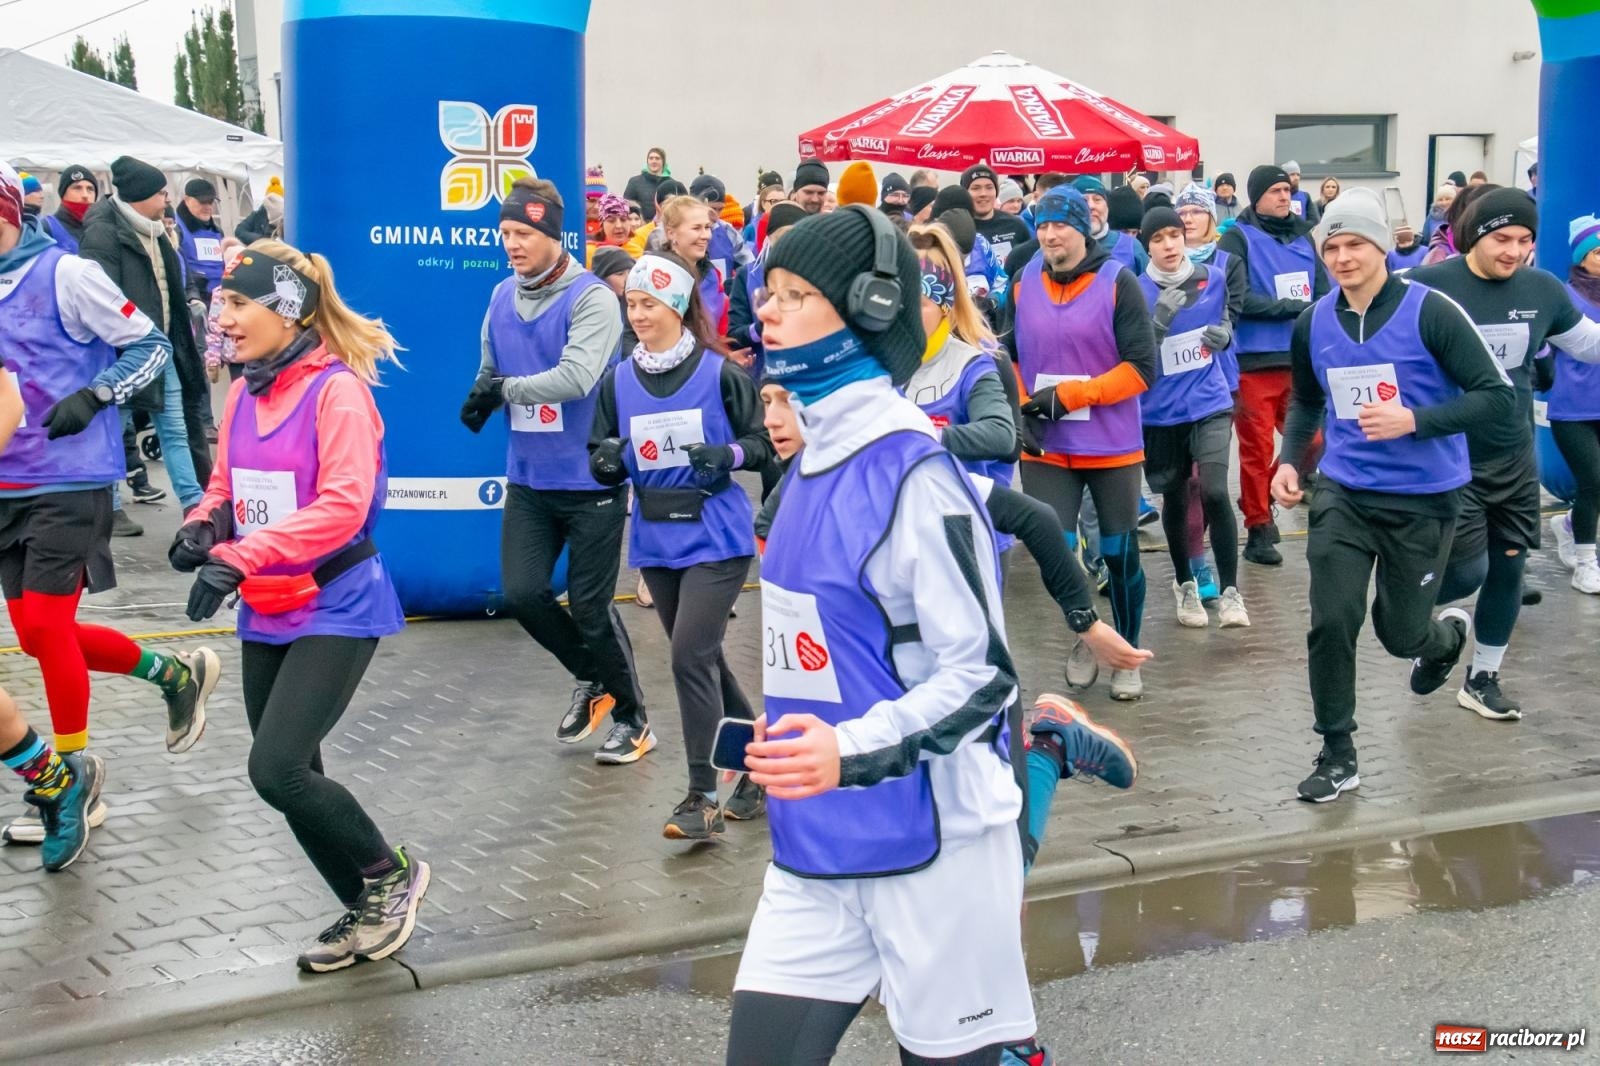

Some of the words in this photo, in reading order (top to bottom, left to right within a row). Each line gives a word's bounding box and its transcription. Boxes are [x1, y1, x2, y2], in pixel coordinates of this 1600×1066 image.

[909, 86, 972, 133] WARKA
[1014, 87, 1063, 136] WARKA
[917, 143, 960, 160] Classic
[994, 151, 1040, 163] WARKA
[1074, 146, 1118, 165] Classic
[369, 225, 444, 245] GMINA
[450, 227, 579, 250] KRZYICE
[417, 257, 454, 269] odkryj
[463, 258, 499, 270] poznaj
[1173, 345, 1202, 366] 106
[1350, 386, 1373, 406] 21
[662, 435, 676, 455] 4
[246, 498, 269, 525] 68
[766, 626, 797, 671] 31
[957, 1008, 994, 1025] STANNO
